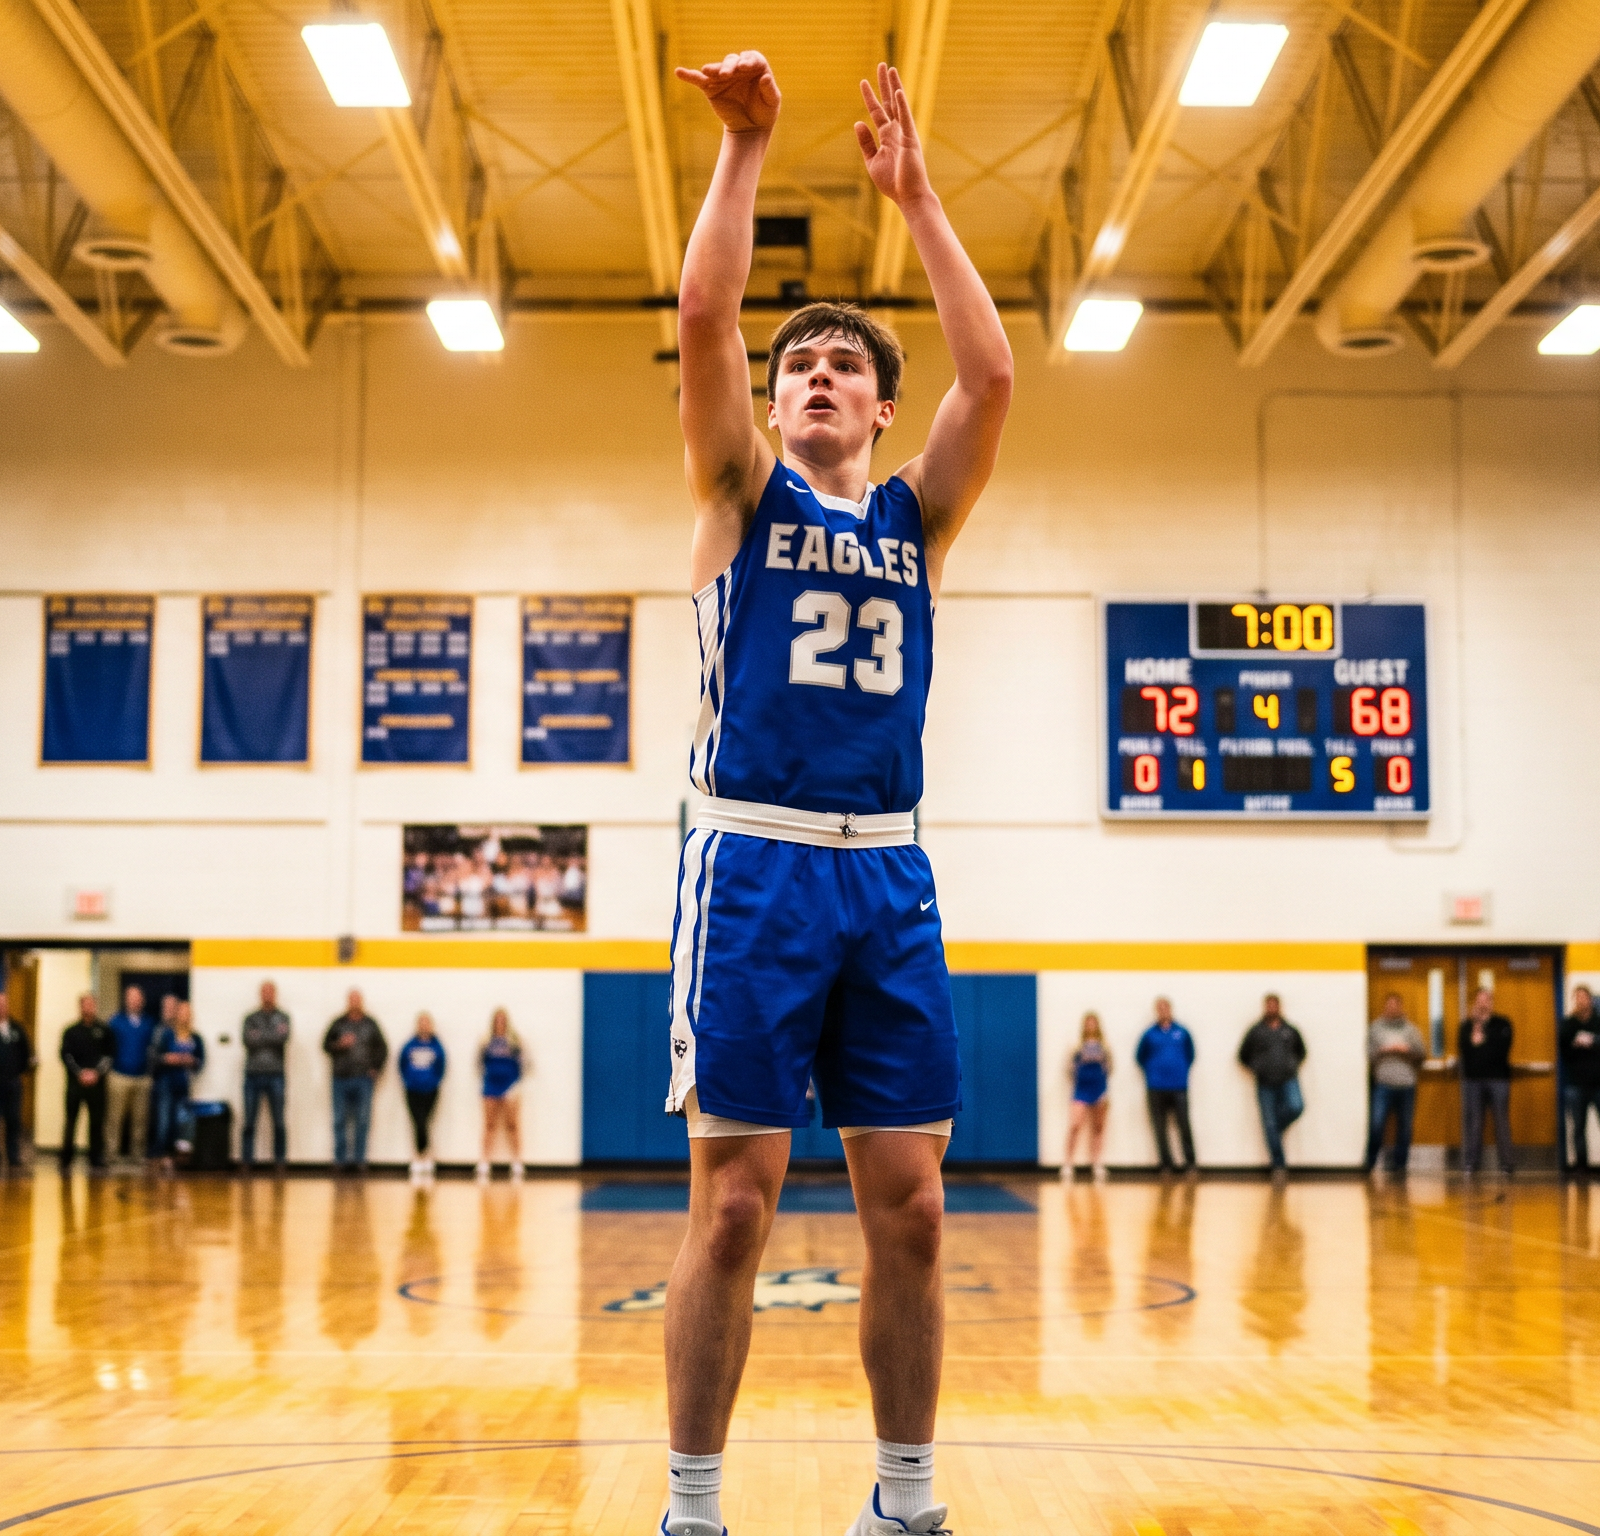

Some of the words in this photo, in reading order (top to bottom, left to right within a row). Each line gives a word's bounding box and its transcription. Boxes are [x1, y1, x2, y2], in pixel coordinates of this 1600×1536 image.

[765, 522, 918, 587] EAGLES
[789, 589, 903, 696] 23
[1231, 603, 1334, 651] 7:00
[1333, 658, 1409, 685] GUEST
[1140, 686, 1199, 736] 72
[1253, 694, 1280, 729] 4
[1351, 687, 1411, 736] 68
[1134, 754, 1160, 793] 0
[1192, 759, 1206, 790] 1
[1330, 755, 1355, 793] 5
[1387, 755, 1411, 794] 0
